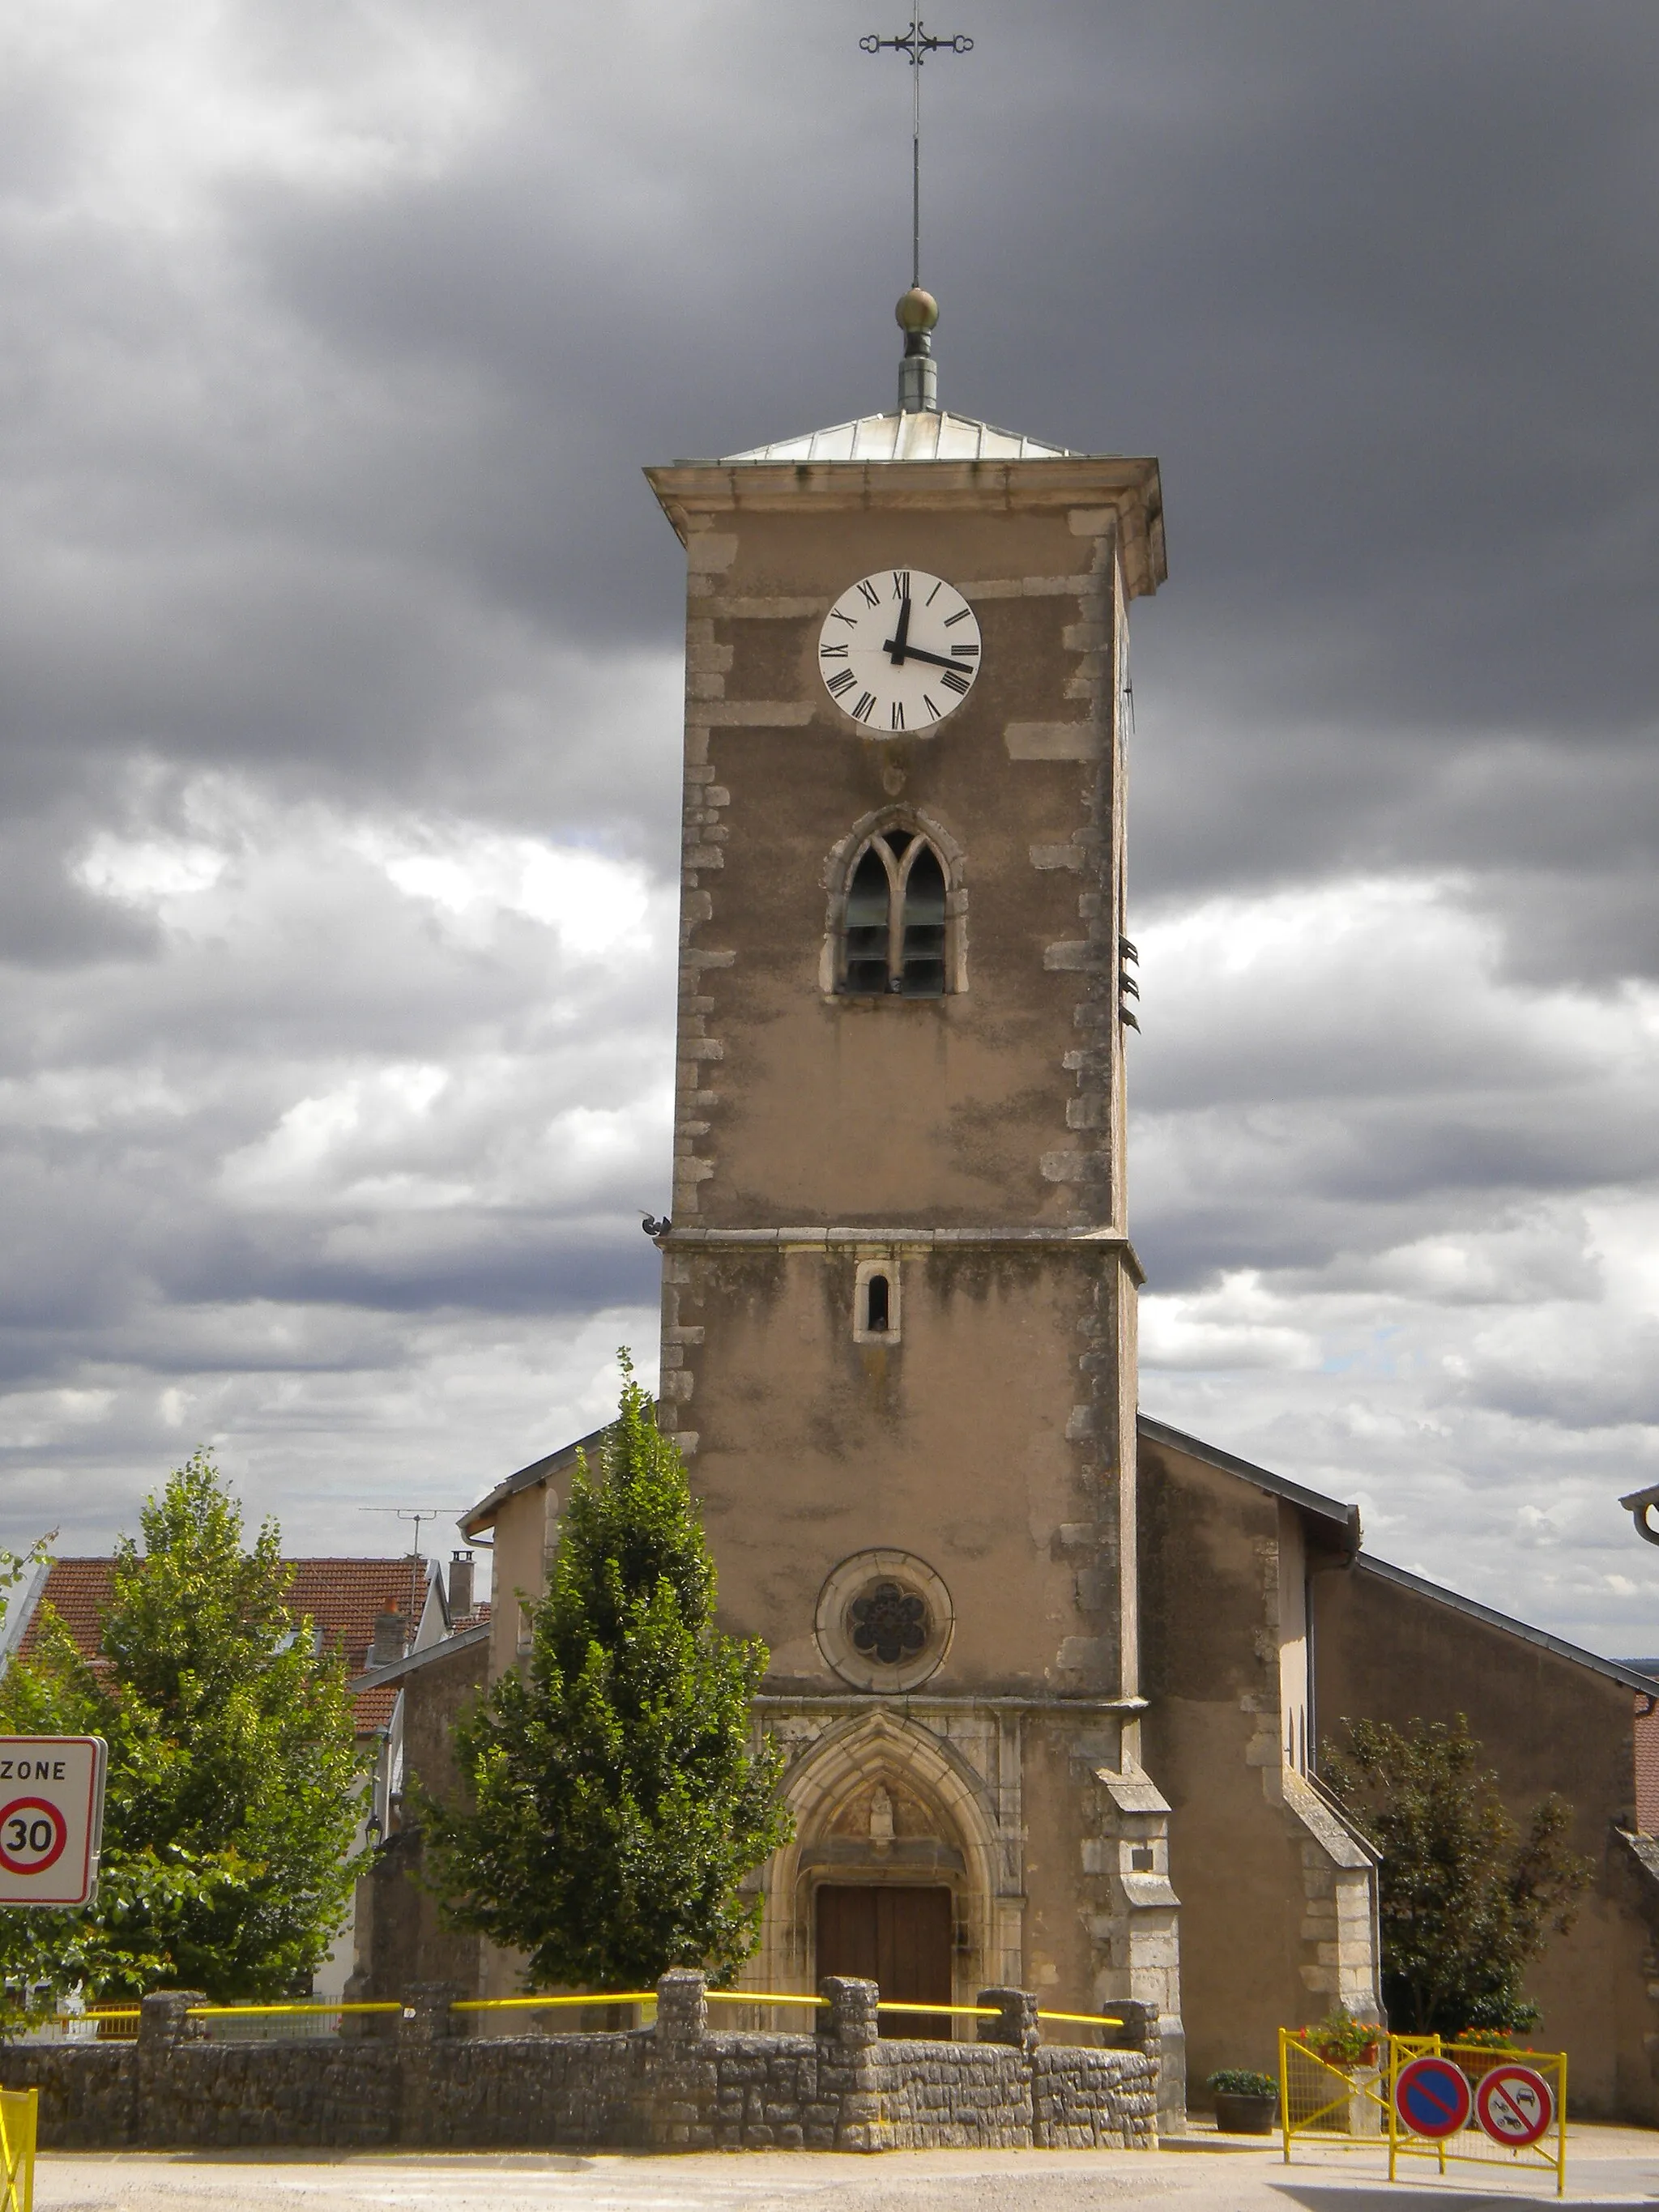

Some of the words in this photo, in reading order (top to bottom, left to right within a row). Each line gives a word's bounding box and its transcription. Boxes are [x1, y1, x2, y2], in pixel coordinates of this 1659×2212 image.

[856, 580, 881, 609] XI
[893, 571, 910, 599] XII
[925, 582, 942, 607] I
[830, 608, 858, 629] X
[944, 608, 971, 628] II
[821, 644, 848, 657] IX
[951, 645, 979, 656] III
[826, 668, 858, 699] VIII
[940, 670, 970, 696] IIII
[851, 692, 876, 723] VII
[892, 701, 905, 730] VI
[923, 694, 941, 721] V
[1, 1761, 66, 1780] ZONE
[6, 1818, 52, 1852] 30
